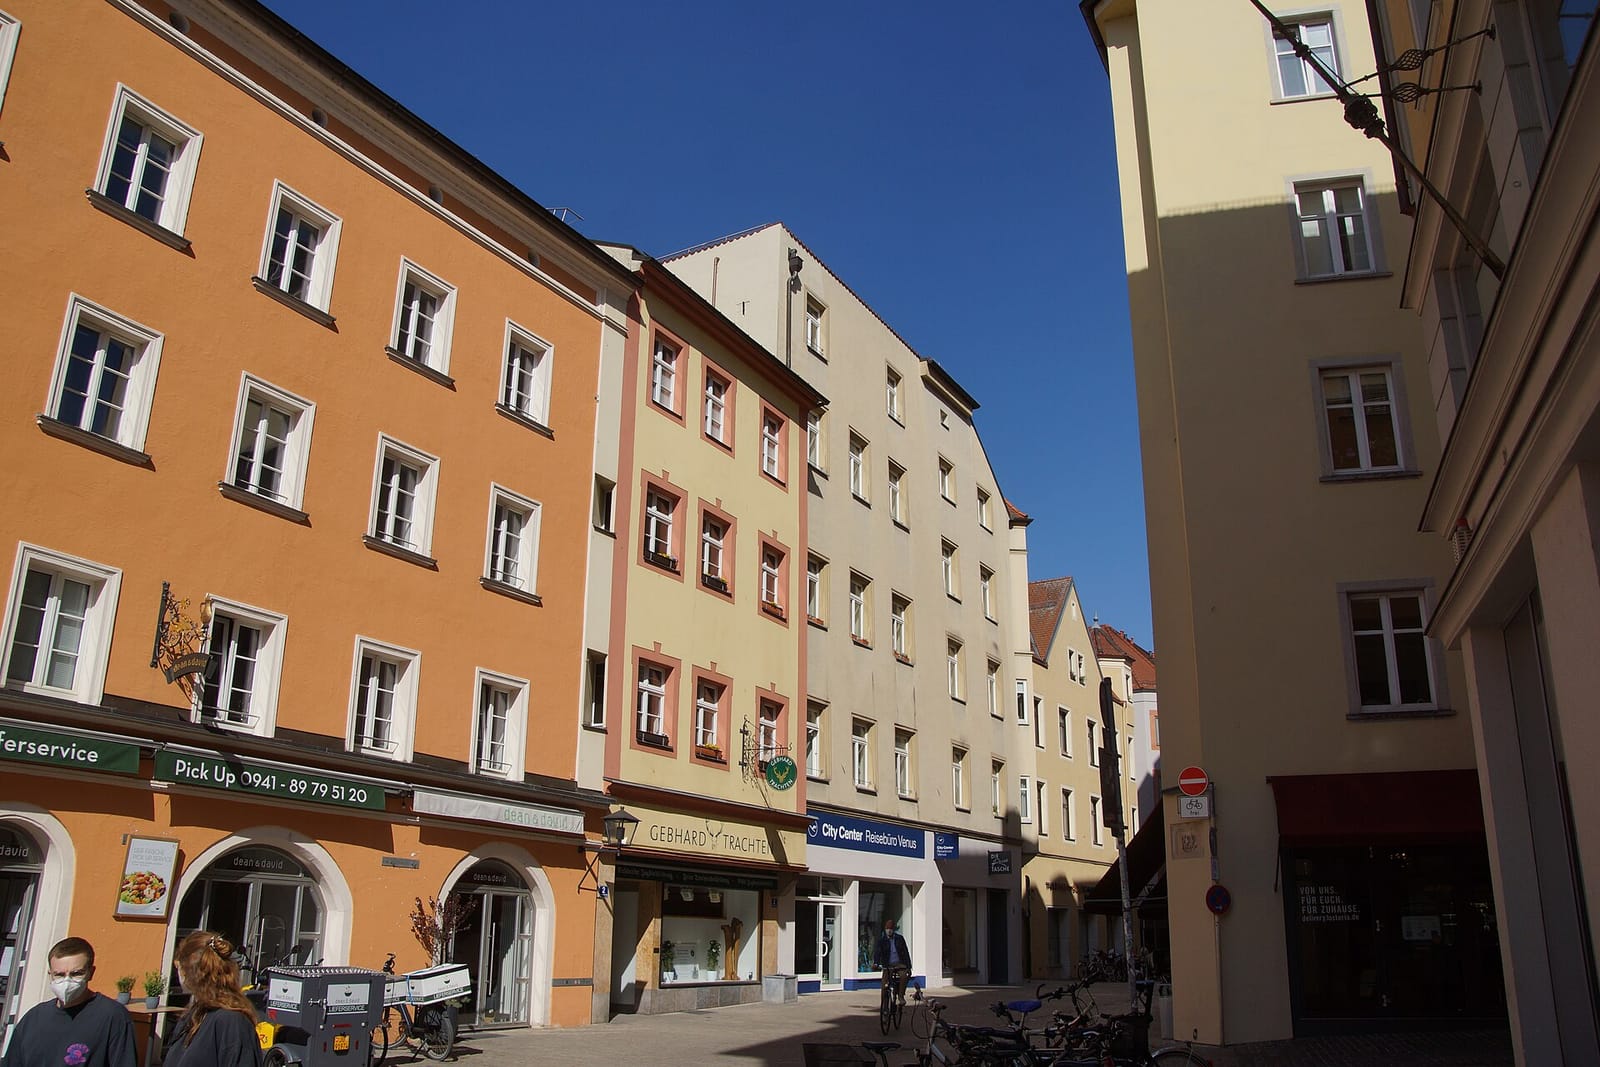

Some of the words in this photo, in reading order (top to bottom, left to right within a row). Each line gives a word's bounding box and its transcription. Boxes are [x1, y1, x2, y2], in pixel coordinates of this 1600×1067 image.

[770, 756, 793, 767] GEBHARD
[175, 759, 209, 780] Pick
[214, 766, 236, 788] Up
[240, 771, 276, 790] 0941
[289, 778, 307, 795] 89
[311, 782, 328, 798] 79
[331, 785, 346, 801] 51
[348, 788, 367, 803] 20
[769, 779, 794, 790] TRACHTEN
[650, 825, 706, 847] GEBHARD
[822, 823, 838, 840] City
[838, 826, 863, 842] Center
[865, 830, 897, 847] Reisebüro
[897, 834, 917, 849] Venus
[1299, 886, 1316, 895] VON
[1301, 895, 1317, 905] FÜR
[1301, 904, 1318, 914] FÜR
